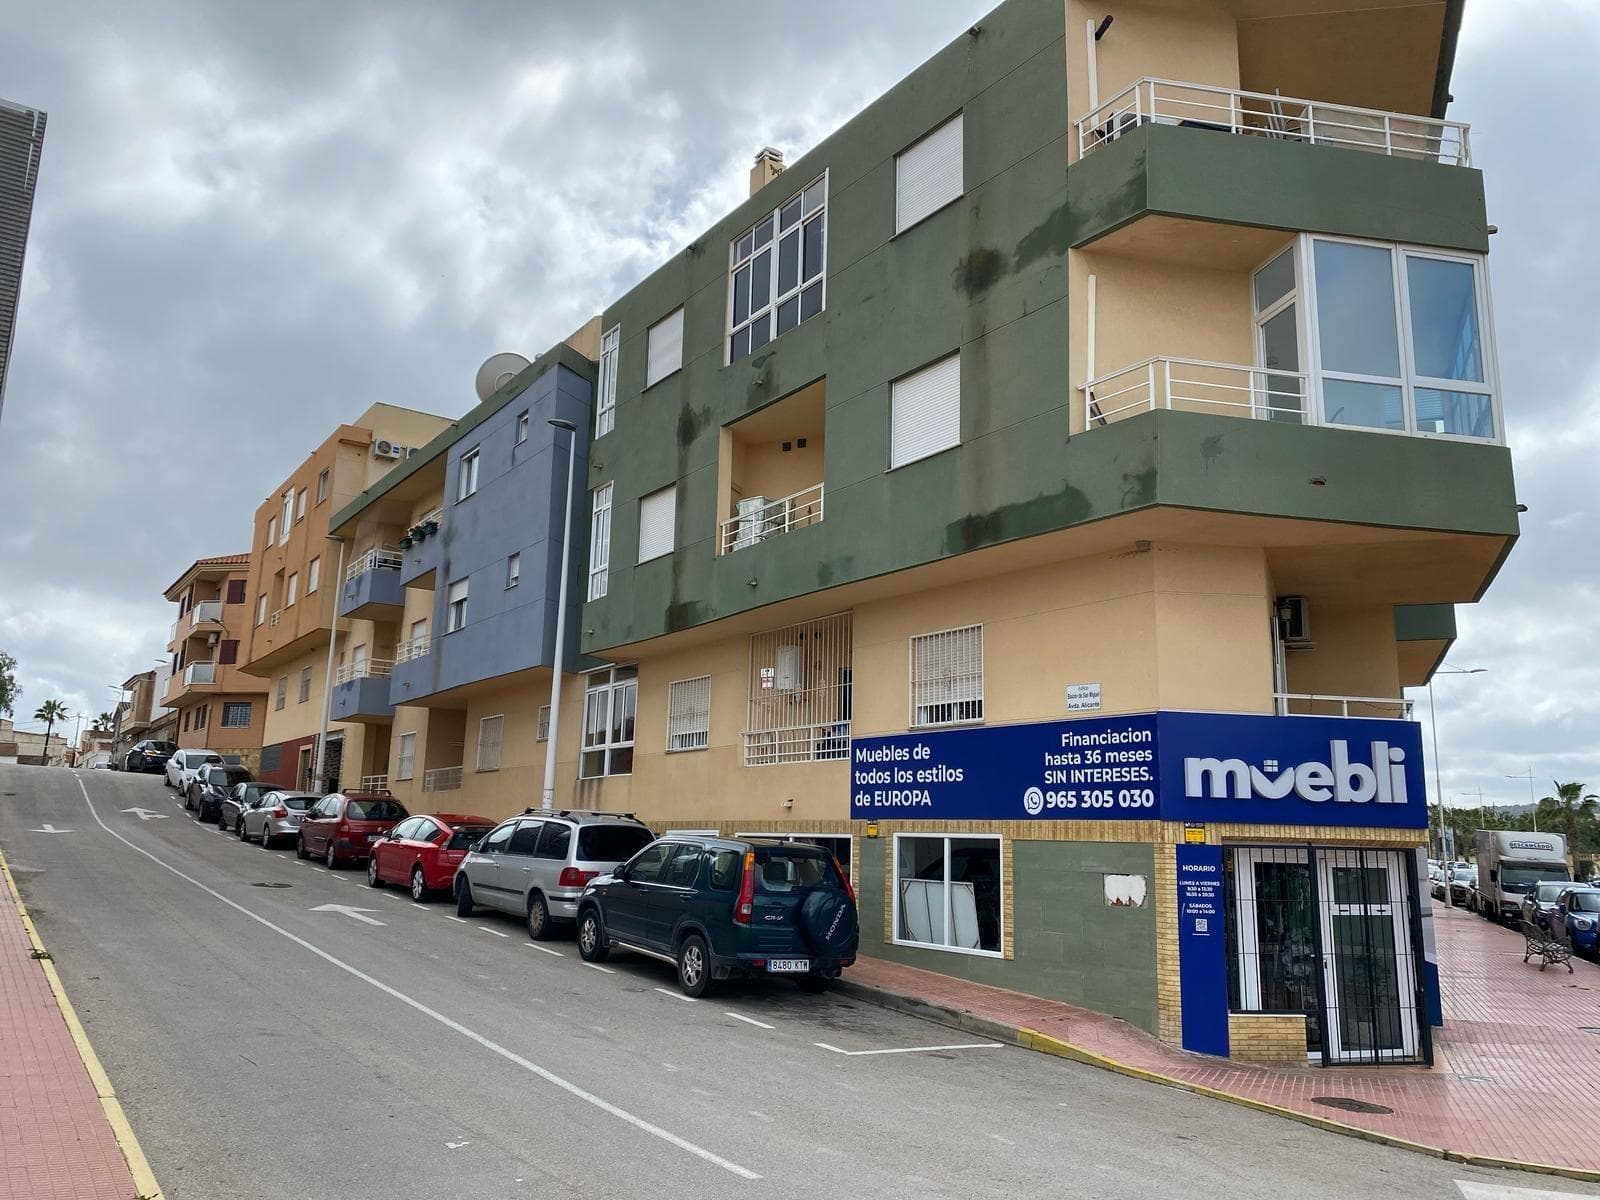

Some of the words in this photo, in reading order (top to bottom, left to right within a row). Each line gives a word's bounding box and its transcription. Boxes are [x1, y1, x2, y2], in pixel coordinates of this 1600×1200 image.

[1061, 727, 1152, 747] Financiacion
[855, 745, 910, 763] Muebles
[912, 743, 931, 760] de
[1045, 752, 1081, 766] hasta
[1084, 750, 1101, 764] 36
[1105, 749, 1153, 763] meses
[855, 768, 891, 785] todos
[894, 767, 914, 783] los
[916, 764, 964, 783] estilos
[1044, 770, 1067, 784] SIN
[1070, 766, 1153, 783] INTERESES.
[855, 790, 871, 806] de
[874, 790, 932, 807] EUROPA
[1045, 791, 1077, 809] 965
[1081, 790, 1114, 808] 305
[1118, 788, 1154, 808] 030
[1182, 864, 1216, 873] HORARIO
[825, 903, 846, 941] HONDA
[772, 960, 792, 970] 8480
